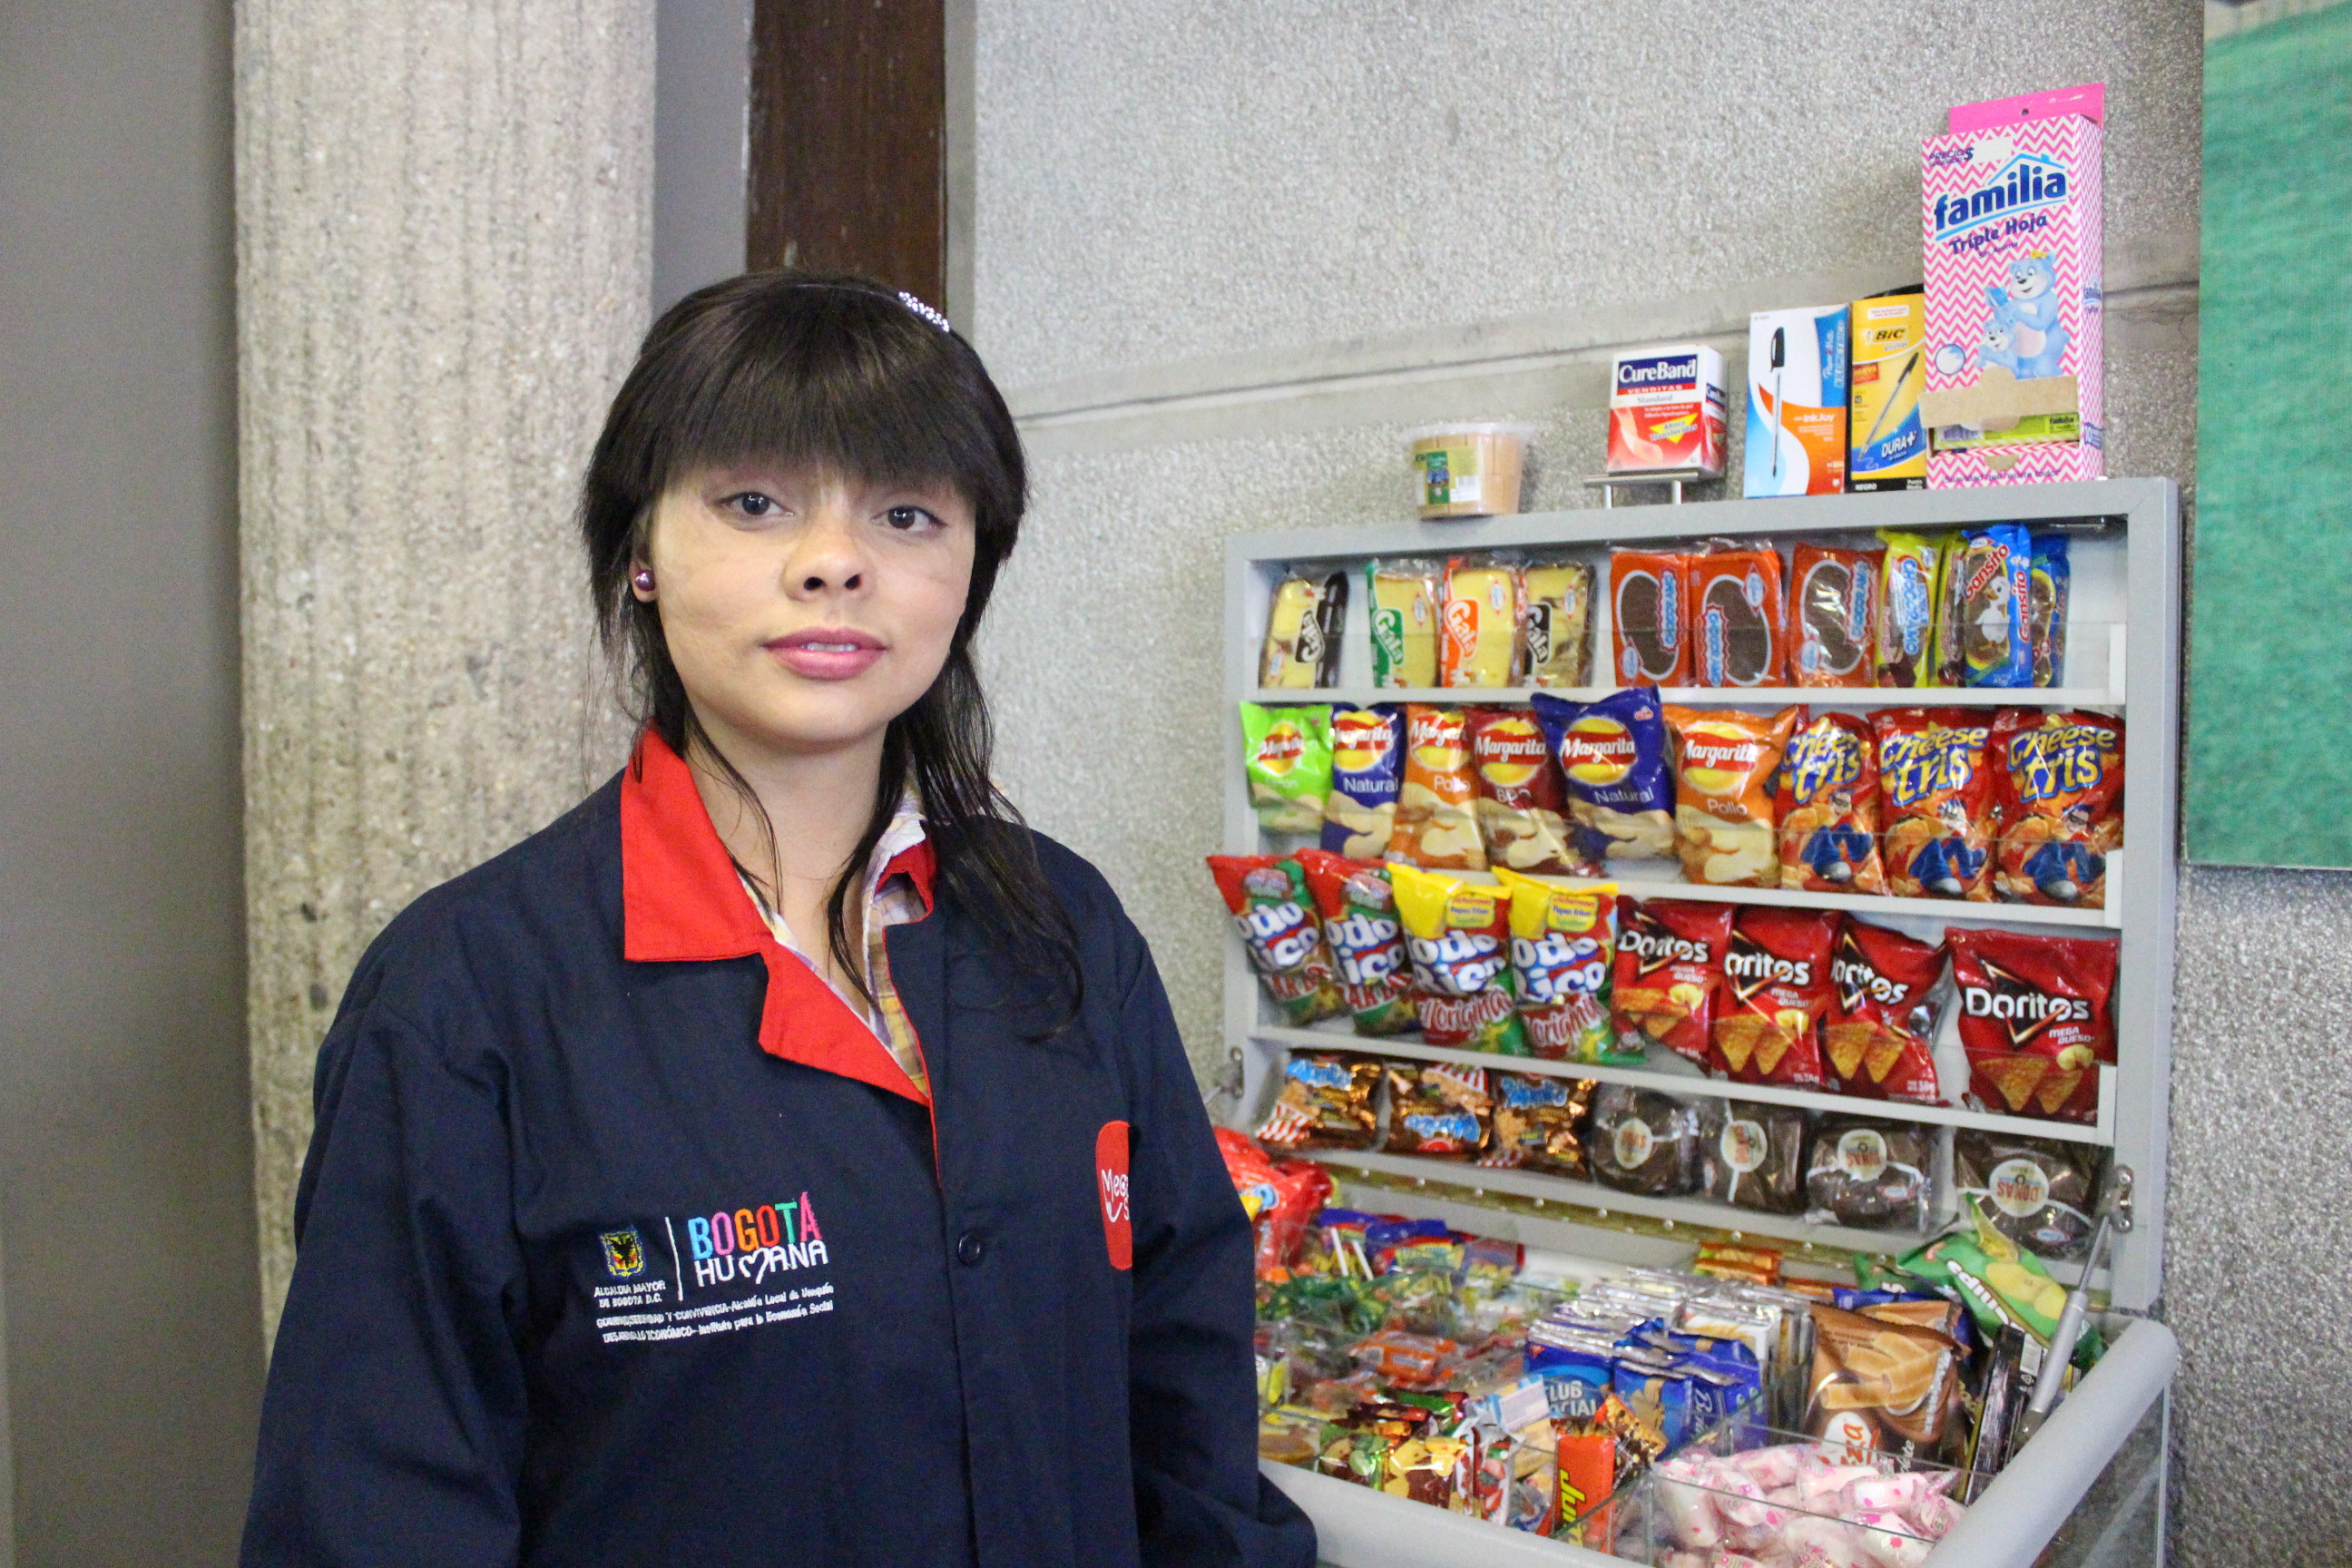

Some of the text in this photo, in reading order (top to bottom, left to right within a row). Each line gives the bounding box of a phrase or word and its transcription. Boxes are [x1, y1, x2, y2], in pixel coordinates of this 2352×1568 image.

[1934, 163, 2066, 230] familia
[1950, 212, 2047, 255] Triple Hoja
[1619, 358, 1697, 383] CureBand
[1637, 394, 1673, 404] Standard
[1803, 413, 1835, 423] InkJoy
[1965, 544, 2010, 601] Gansito
[2013, 570, 2031, 643] Gansito
[1375, 610, 1402, 665] Gala
[1447, 602, 1475, 658] Gala
[1475, 736, 1546, 762] Margarita
[1560, 738, 1635, 763] Margarita
[1879, 727, 1989, 769] Cheese
[2008, 726, 2117, 769] Cheese
[1343, 776, 1398, 793] Natural
[1896, 748, 1969, 805] tris
[2022, 747, 2102, 803] tris
[1594, 786, 1654, 804] Natural
[1707, 799, 1748, 815] Pollo
[1232, 902, 1305, 941] odo
[1324, 913, 1398, 952] odo
[1412, 929, 1498, 966] odo
[1514, 933, 1599, 967] odo
[1619, 930, 1709, 963] Doritos
[1724, 952, 1811, 986] oritos
[1831, 956, 1909, 1004] oritos
[1771, 987, 1798, 999] MEGA
[1965, 986, 2092, 1022] Doritos
[2049, 1026, 2080, 1038] MEGA
[2057, 1035, 2092, 1044] QUESO
[694, 1240, 828, 1288] HUMANA
[633, 1279, 666, 1294] MAYOR
[645, 1293, 662, 1305] D.C.
[665, 1312, 672, 1322] Y
[765, 1291, 787, 1305] Local
[734, 1317, 754, 1331] para
[809, 1299, 834, 1314] Social
[1544, 1379, 1583, 1401] LUB
